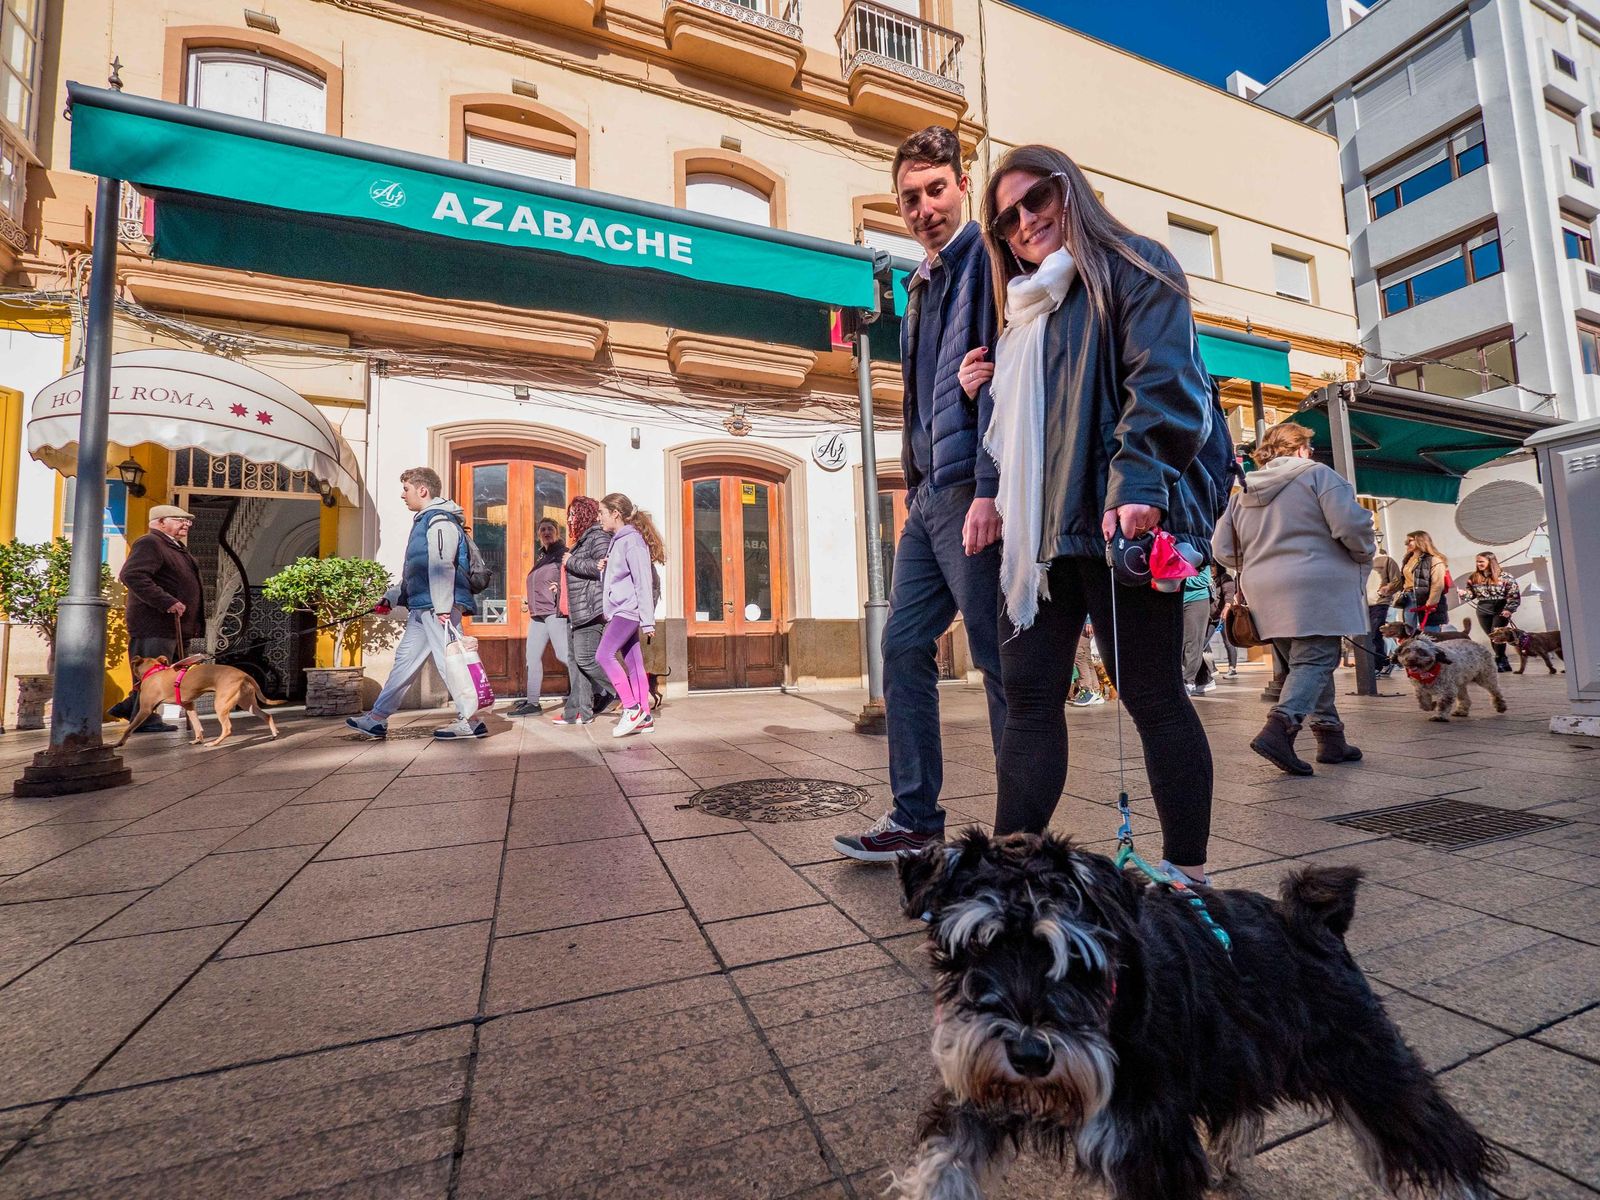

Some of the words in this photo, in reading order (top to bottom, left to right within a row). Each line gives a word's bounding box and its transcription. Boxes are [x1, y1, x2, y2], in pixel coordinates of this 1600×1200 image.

[432, 192, 692, 264] AZABACHE
[51, 386, 124, 408] HOL
[130, 387, 215, 410] ROMA
